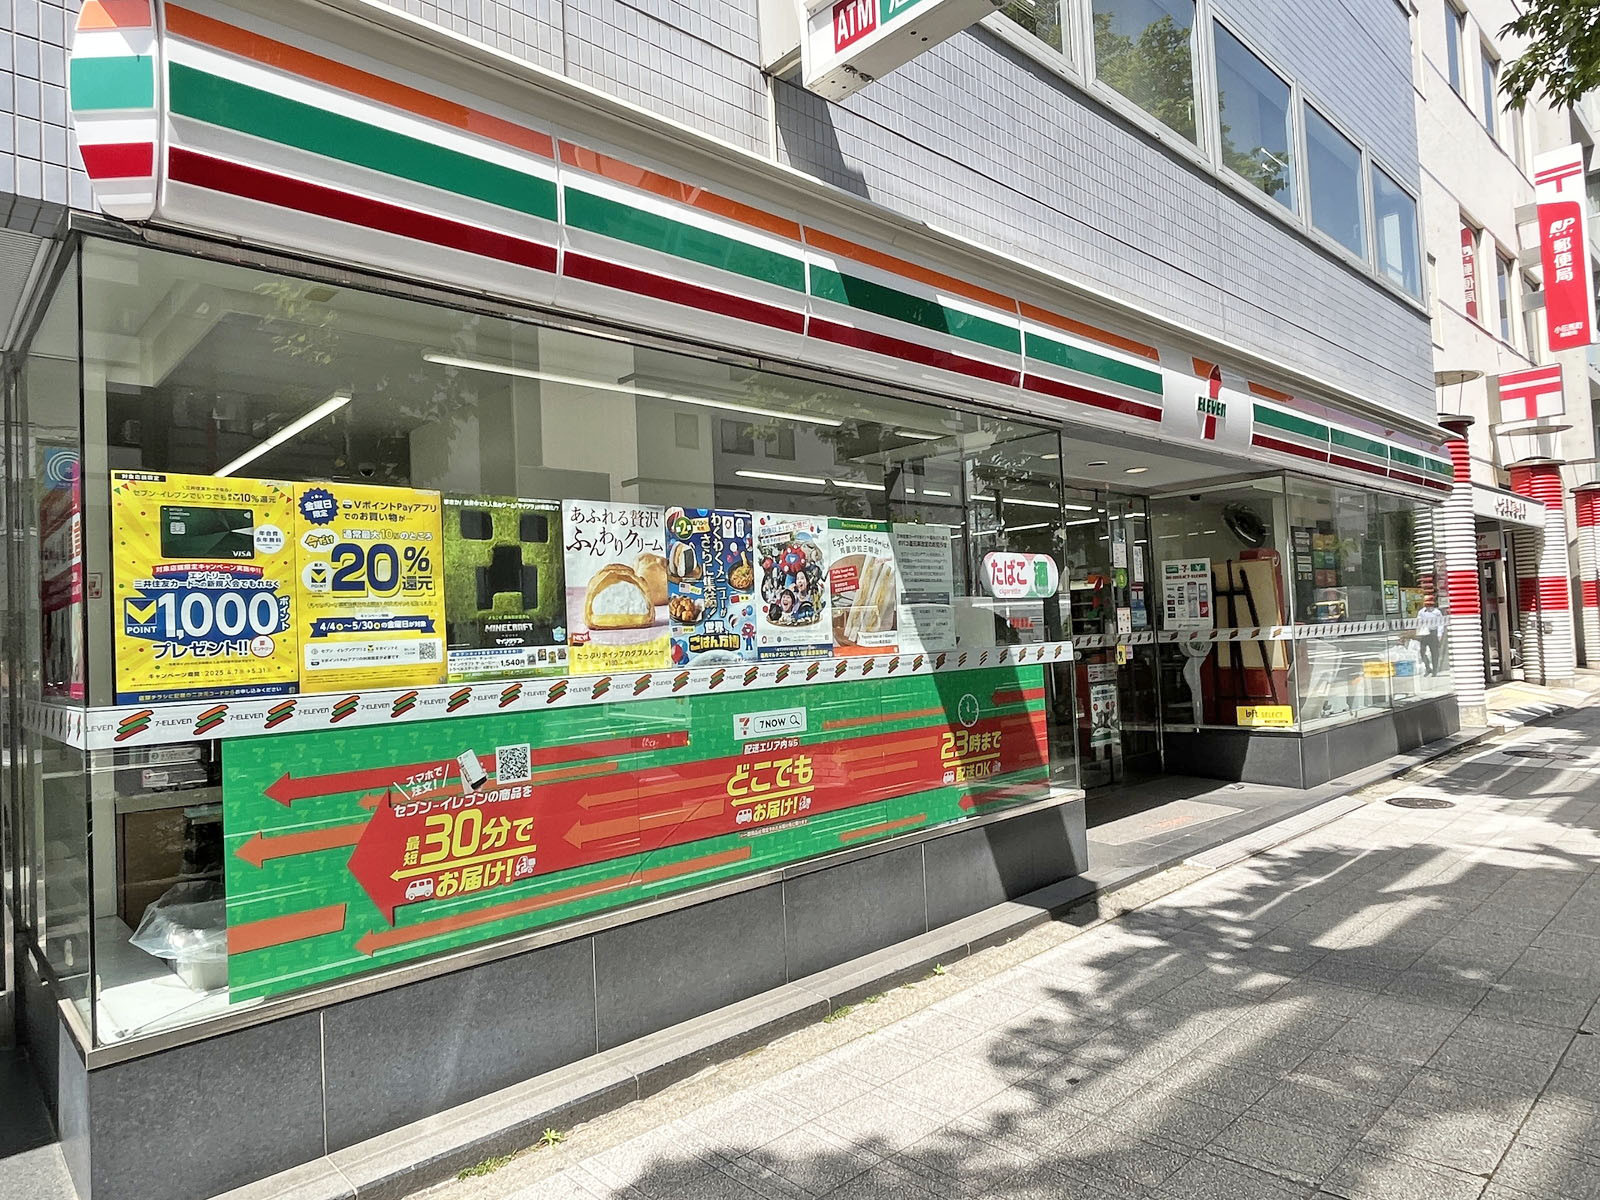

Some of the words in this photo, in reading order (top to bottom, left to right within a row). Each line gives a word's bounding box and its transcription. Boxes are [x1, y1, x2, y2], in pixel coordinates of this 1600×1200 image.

[837, 0, 873, 45] ATM
[1553, 236, 1574, 284] 郵便局
[304, 500, 333, 511] 金曜日
[353, 500, 437, 513] VポイントPayアプリ
[570, 506, 660, 528] あふれる贅沢
[566, 526, 664, 557] ふんわりクリーム
[832, 537, 845, 548] Egg
[845, 533, 862, 544] Salad
[863, 534, 890, 550] Sandwich
[710, 512, 728, 618] わくわくメニューが
[991, 559, 1027, 587] たばこ
[158, 591, 279, 640] 1,000
[278, 596, 291, 630] ポイント
[126, 625, 157, 635] POINT
[484, 622, 534, 633] MINECRAFT
[573, 633, 590, 642] NEW
[152, 640, 249, 660] プレゼント!!
[689, 633, 740, 652] ごはん万博
[760, 718, 786, 729] 7NOW
[940, 729, 1002, 760] 23時まで
[405, 766, 443, 788] スマホで
[411, 780, 438, 798] 注文!
[727, 754, 813, 797] どこでも
[753, 796, 798, 823] お届け!
[420, 808, 534, 865] 30分で
[402, 835, 420, 867] 最短
[435, 858, 514, 898] お届け!
